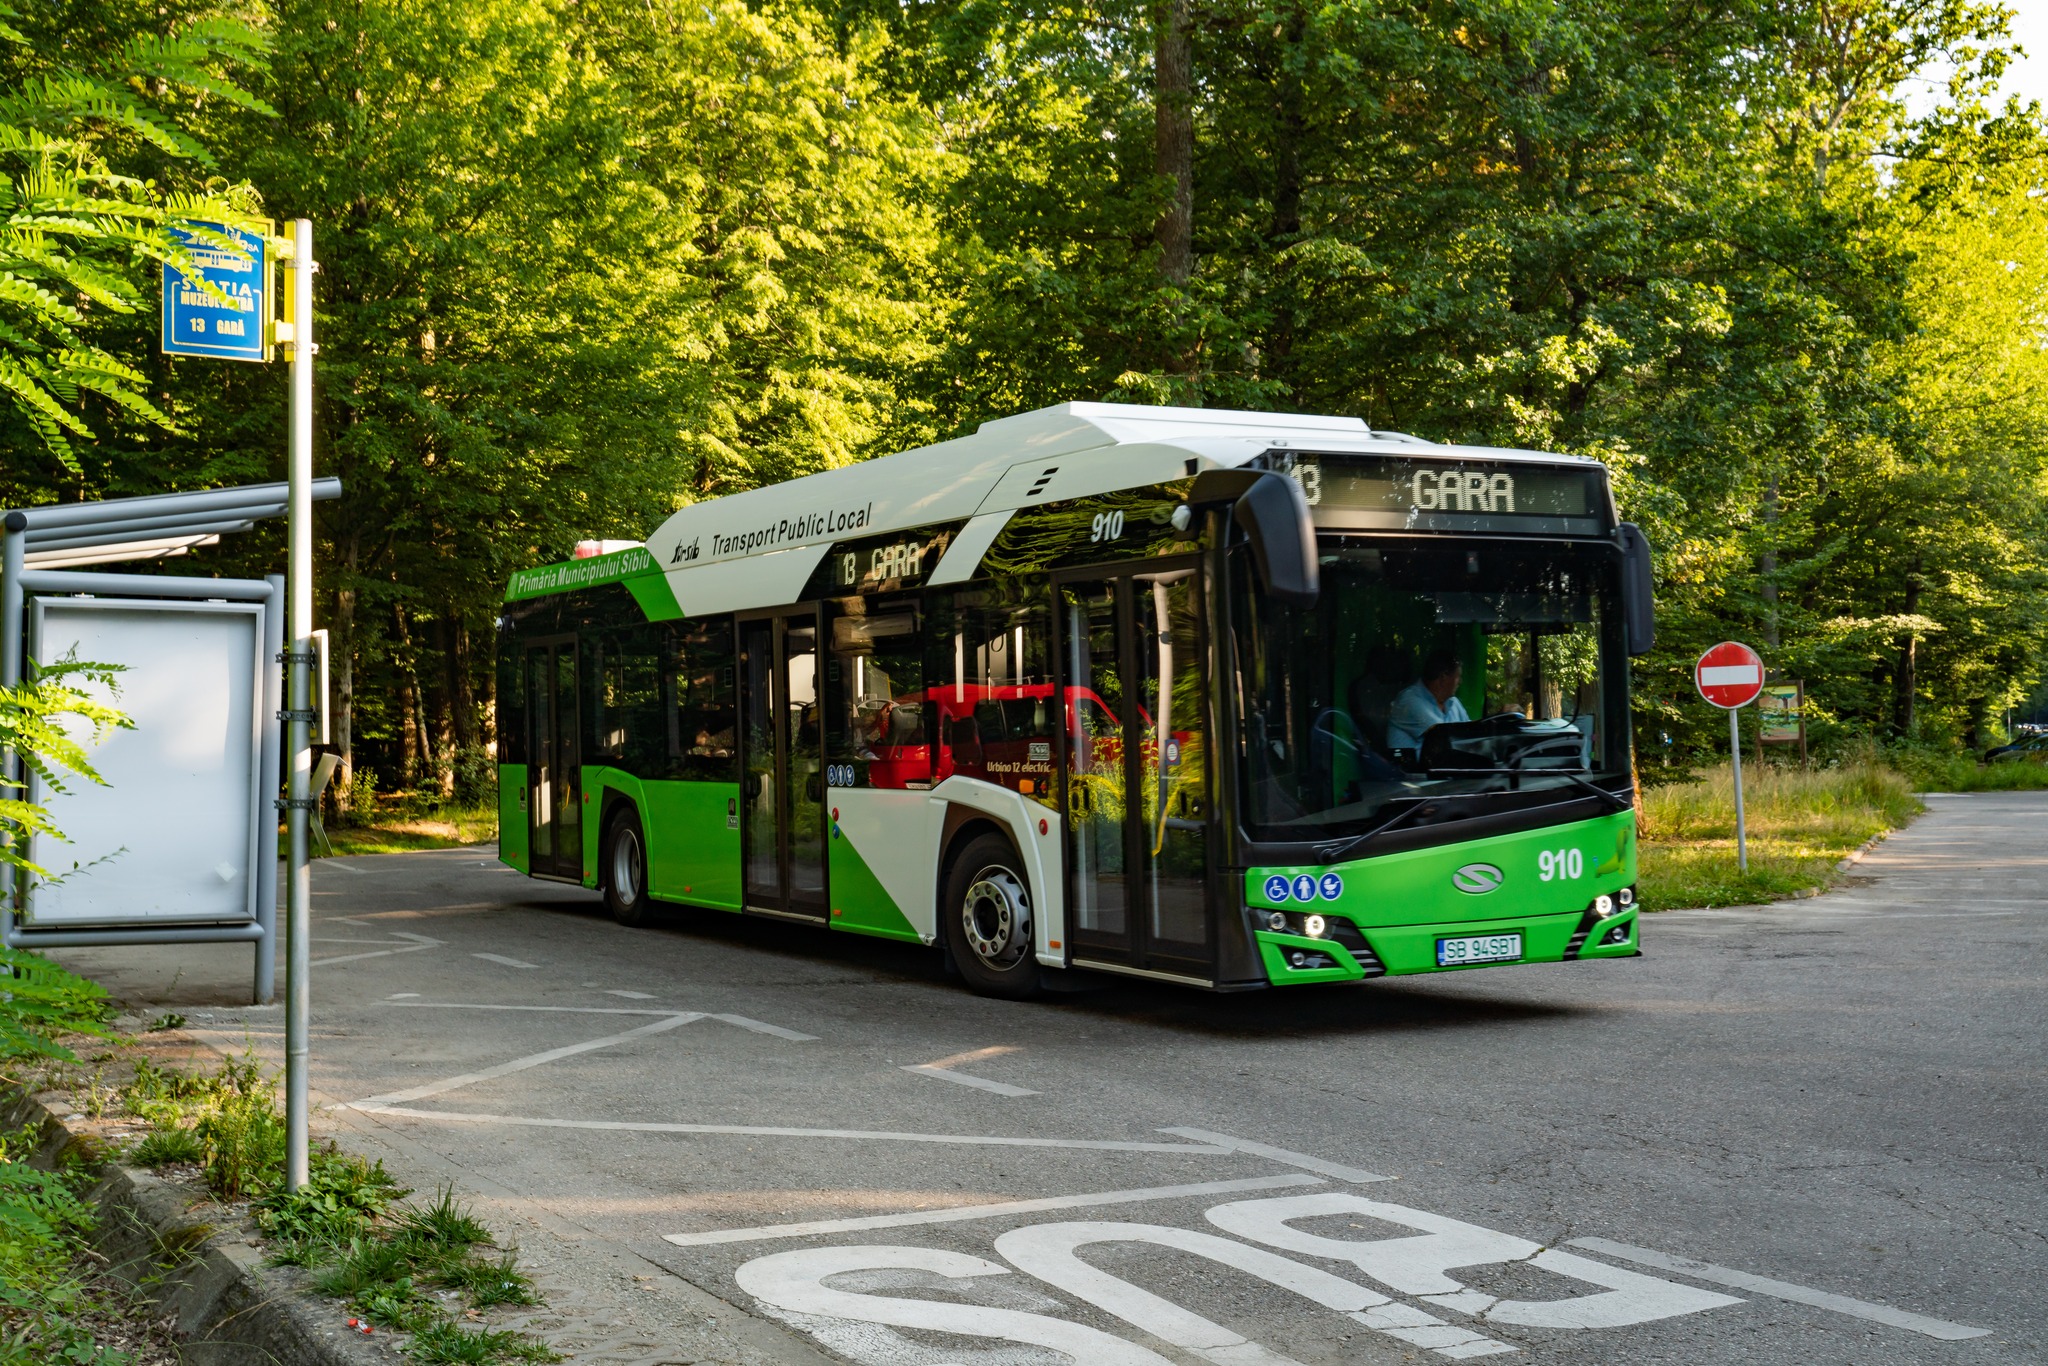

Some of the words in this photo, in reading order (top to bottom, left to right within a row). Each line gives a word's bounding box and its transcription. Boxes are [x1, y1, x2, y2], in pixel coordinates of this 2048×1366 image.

[182, 277, 252, 297] STIA
[190, 318, 205, 333] 13
[1412, 469, 1516, 512] GARA
[712, 522, 776, 556] Transport
[777, 512, 823, 543] Public
[827, 502, 873, 533] Local
[1090, 509, 1124, 543] 910
[517, 570, 557, 594] Primăria
[557, 557, 620, 587] Municipiului
[621, 549, 650, 574] Sibiu
[843, 552, 856, 585] 13
[872, 542, 920, 581] GARA
[987, 761, 1011, 773] Urbino
[1012, 761, 1020, 773] 12
[1021, 761, 1051, 773] electric
[1538, 847, 1583, 882] 910
[1446, 941, 1466, 959] SB
